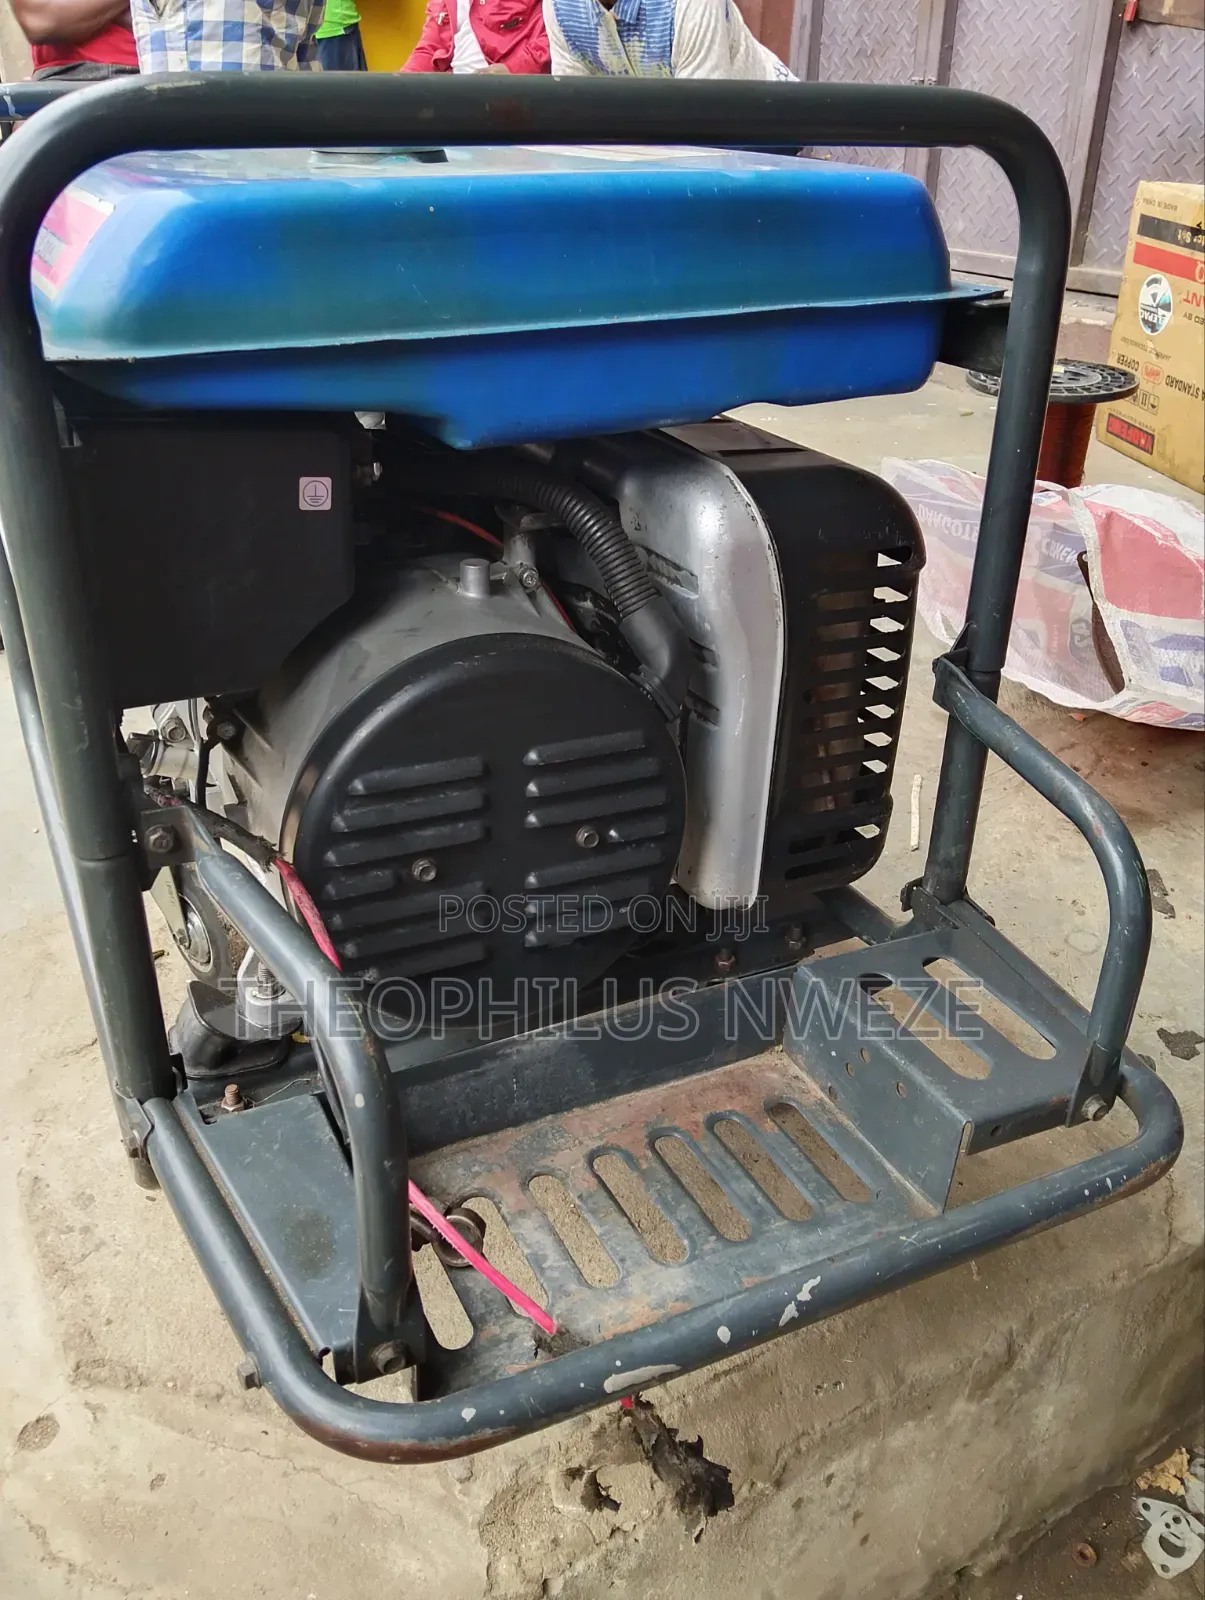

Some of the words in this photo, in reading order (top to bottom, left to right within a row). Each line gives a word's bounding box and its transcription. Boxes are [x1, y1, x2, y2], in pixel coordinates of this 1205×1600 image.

[1183, 290, 1205, 307] NT
[1116, 353, 1140, 374] COPPER
[1165, 375, 1200, 399] STANDARD
